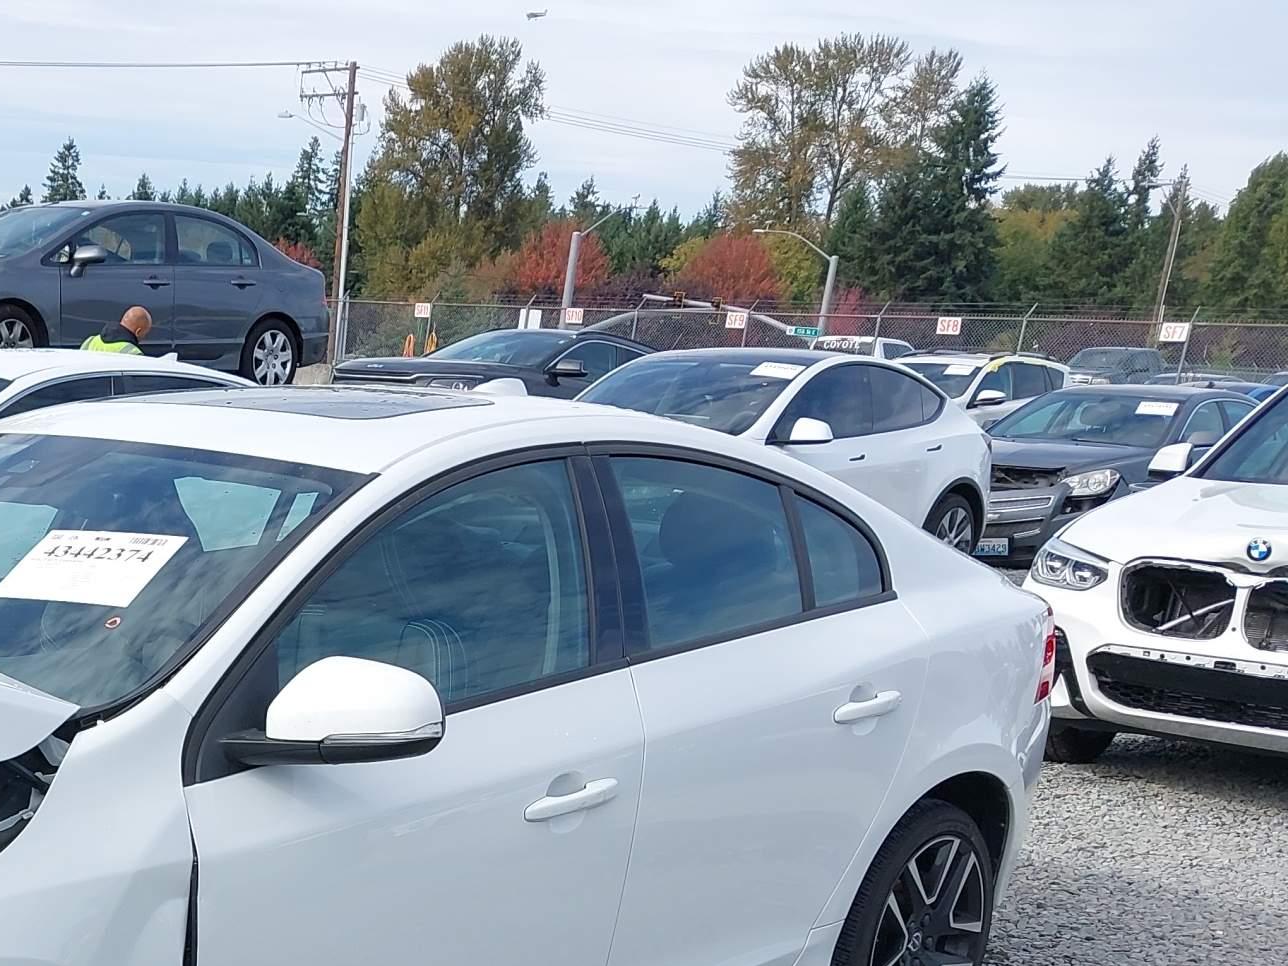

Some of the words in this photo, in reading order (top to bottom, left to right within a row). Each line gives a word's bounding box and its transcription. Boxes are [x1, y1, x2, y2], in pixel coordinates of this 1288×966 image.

[566, 310, 582, 322] SF10
[727, 313, 745, 327] SF9
[939, 319, 959, 333] SF8
[1163, 325, 1186, 339] SF7
[823, 340, 861, 350] COYOTE
[43, 545, 154, 562] 43442374
